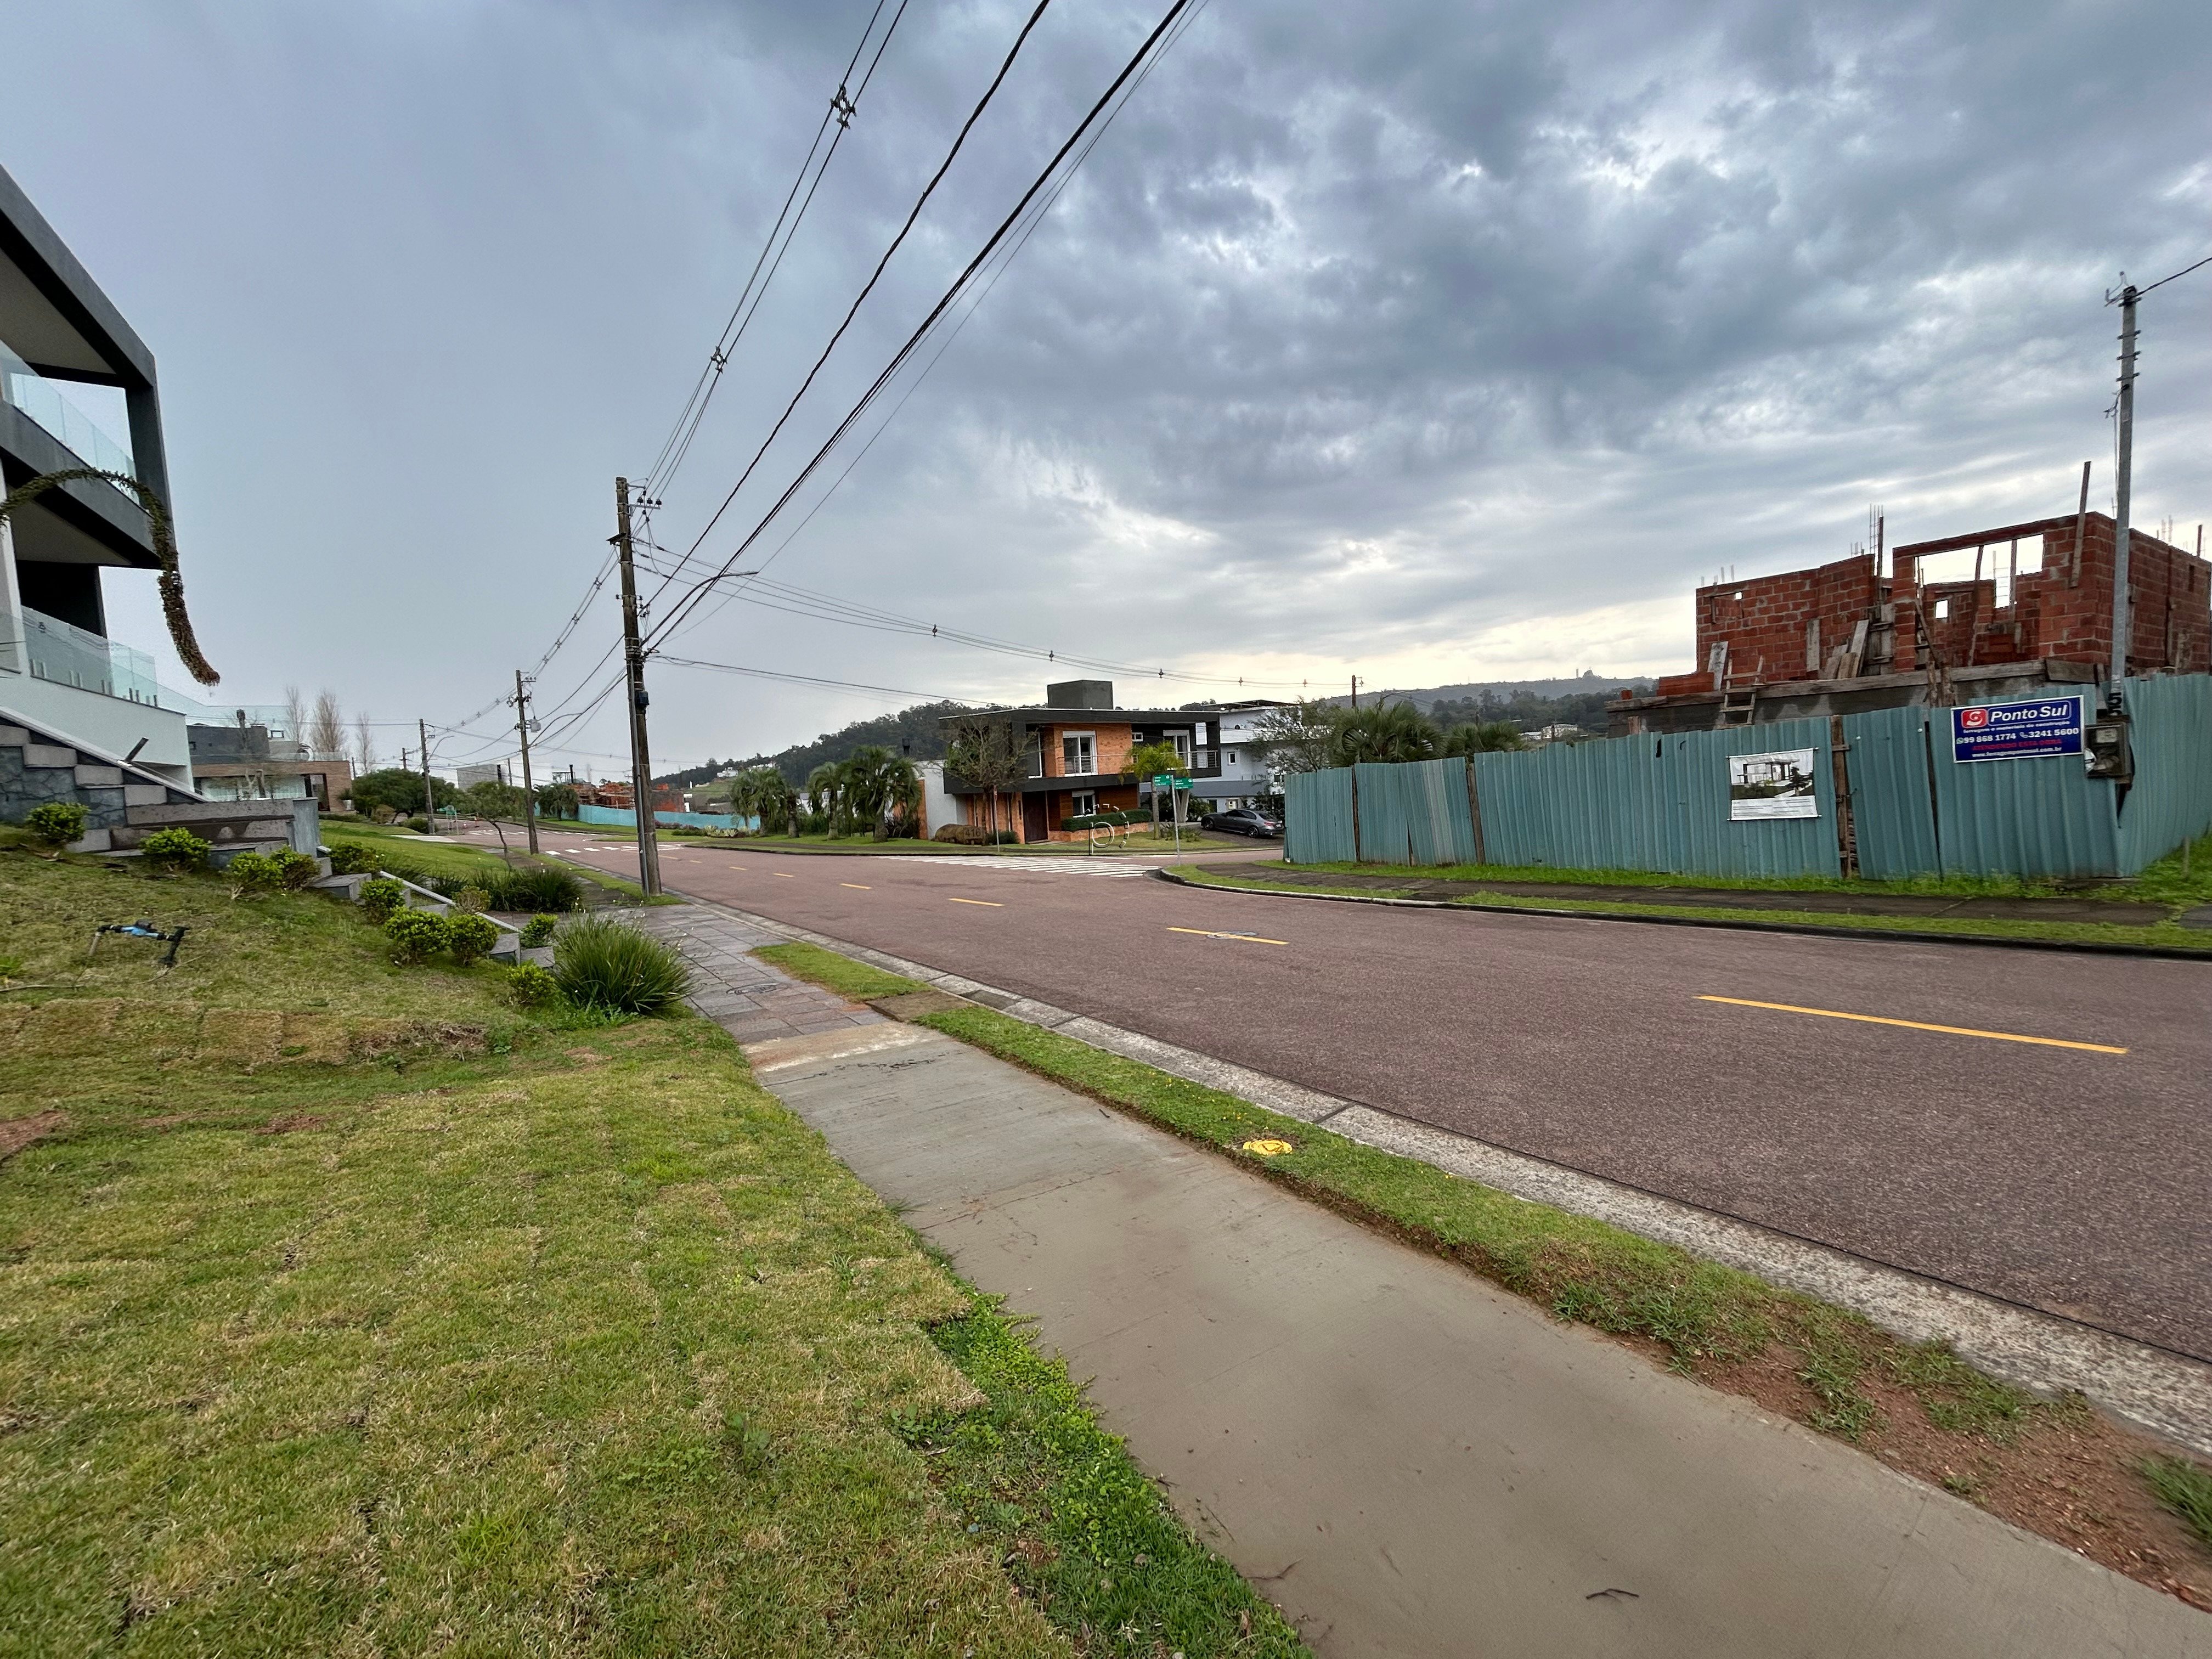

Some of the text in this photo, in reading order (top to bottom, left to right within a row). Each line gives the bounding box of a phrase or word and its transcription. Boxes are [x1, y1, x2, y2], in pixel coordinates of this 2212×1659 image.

[1990, 704, 2068, 723] Ponto Sul
[2028, 730, 2052, 738] 3241
[2054, 727, 2079, 736] 5600
[965, 828, 981, 837] 416
